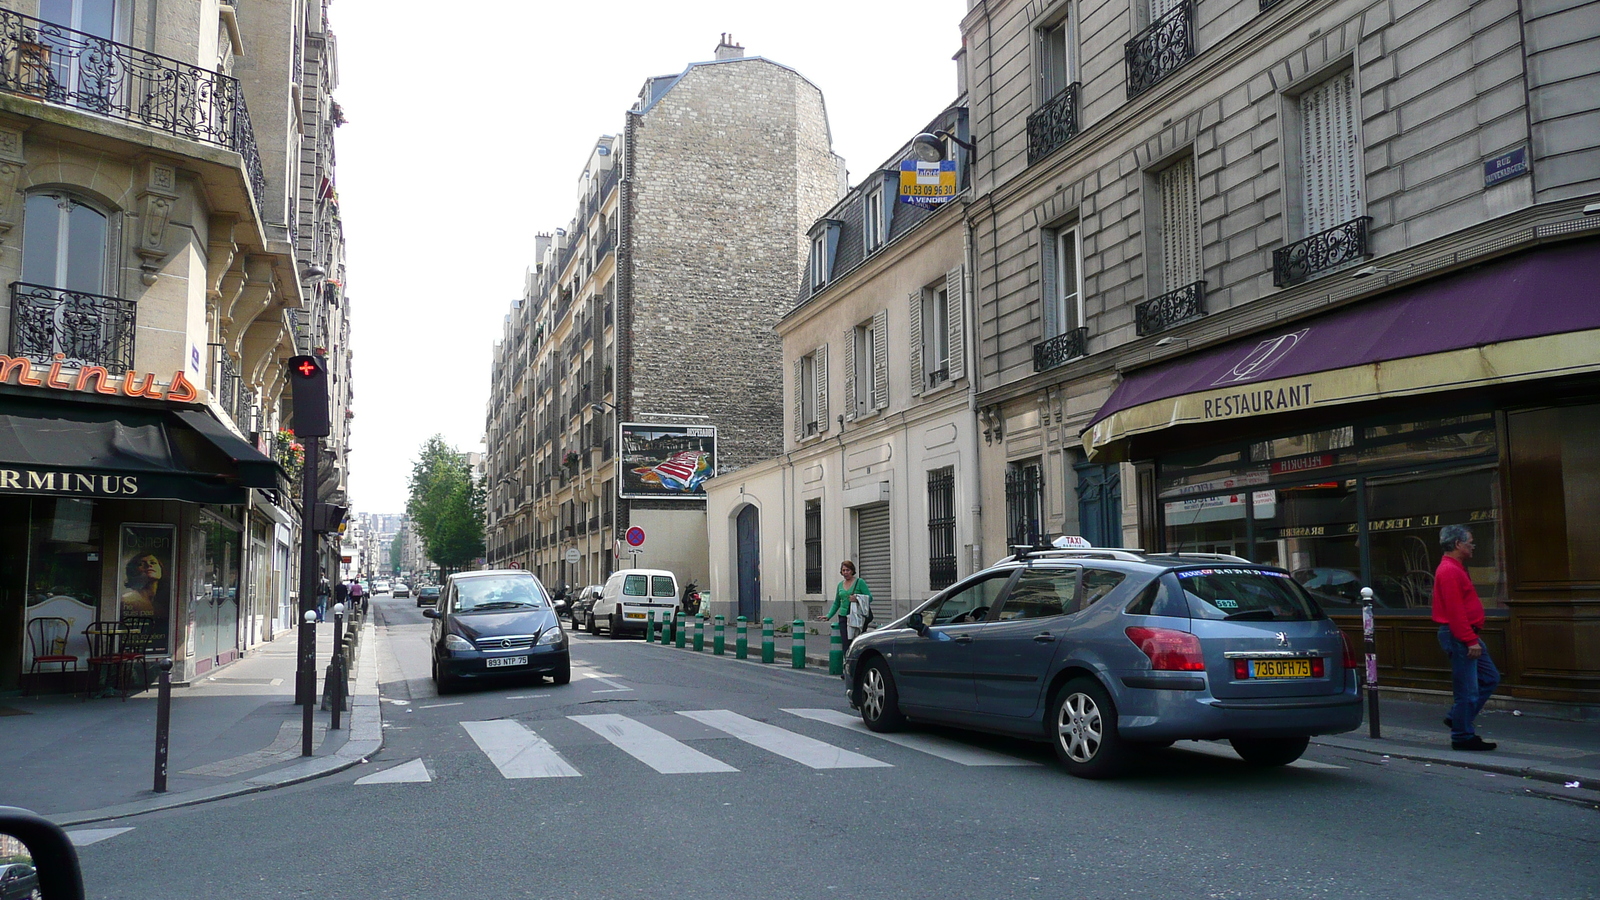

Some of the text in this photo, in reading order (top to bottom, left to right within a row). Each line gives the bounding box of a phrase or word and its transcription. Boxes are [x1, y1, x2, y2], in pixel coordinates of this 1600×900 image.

[1496, 156, 1512, 169] RUE
[903, 184, 953, 195] 01 53 09 96 30
[1204, 383, 1312, 419] RESTAURANT
[488, 656, 527, 667] 893 NTP 75
[1255, 661, 1309, 676] 736 QFH 75
